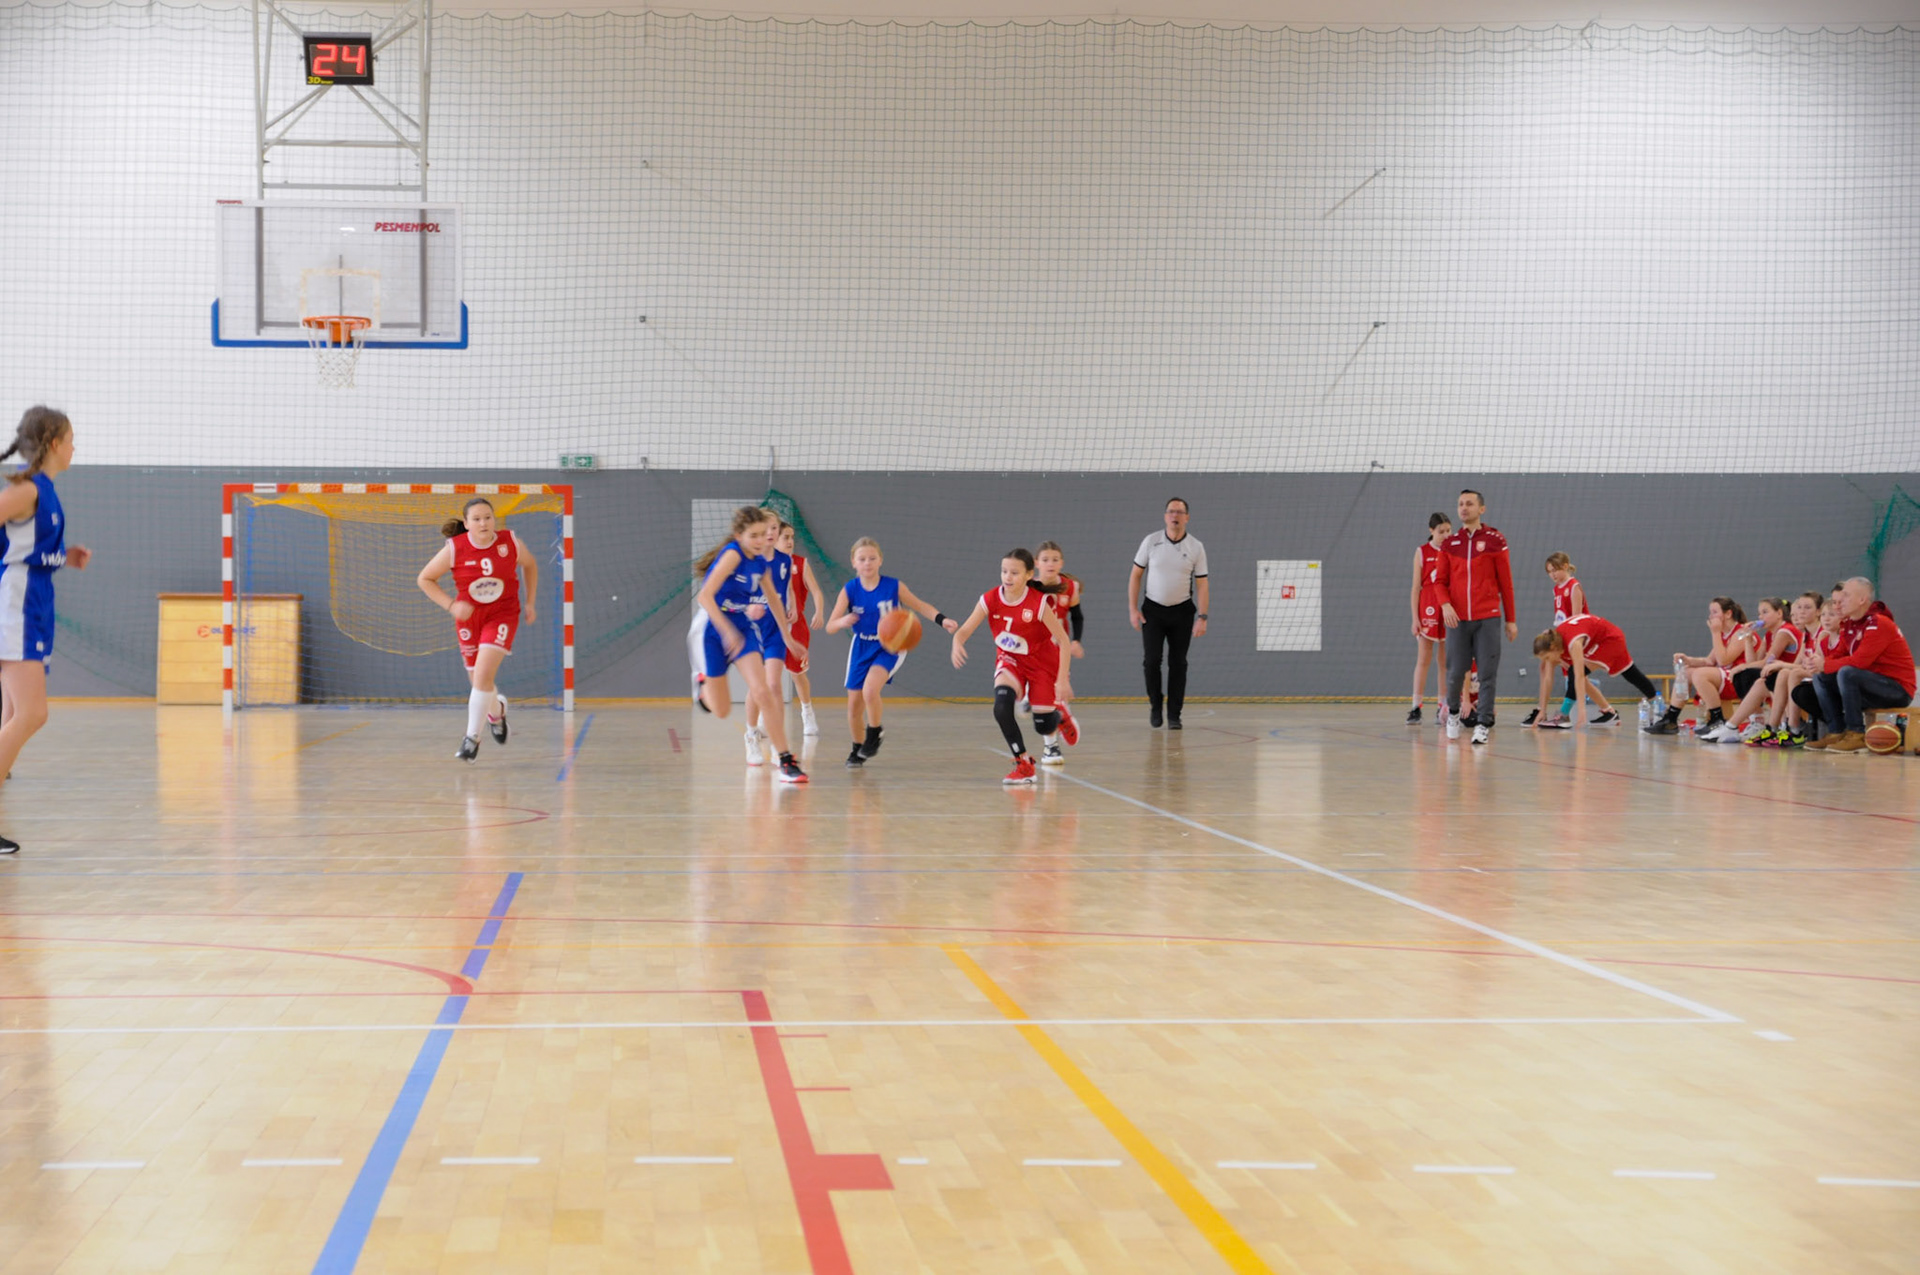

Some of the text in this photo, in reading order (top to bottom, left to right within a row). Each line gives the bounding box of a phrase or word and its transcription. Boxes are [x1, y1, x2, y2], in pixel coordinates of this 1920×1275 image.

[312, 44, 366, 76] 24
[374, 222, 441, 232] PESMENPOL
[480, 558, 493, 576] 9
[497, 623, 508, 641] 9
[1003, 616, 1013, 632] 7
